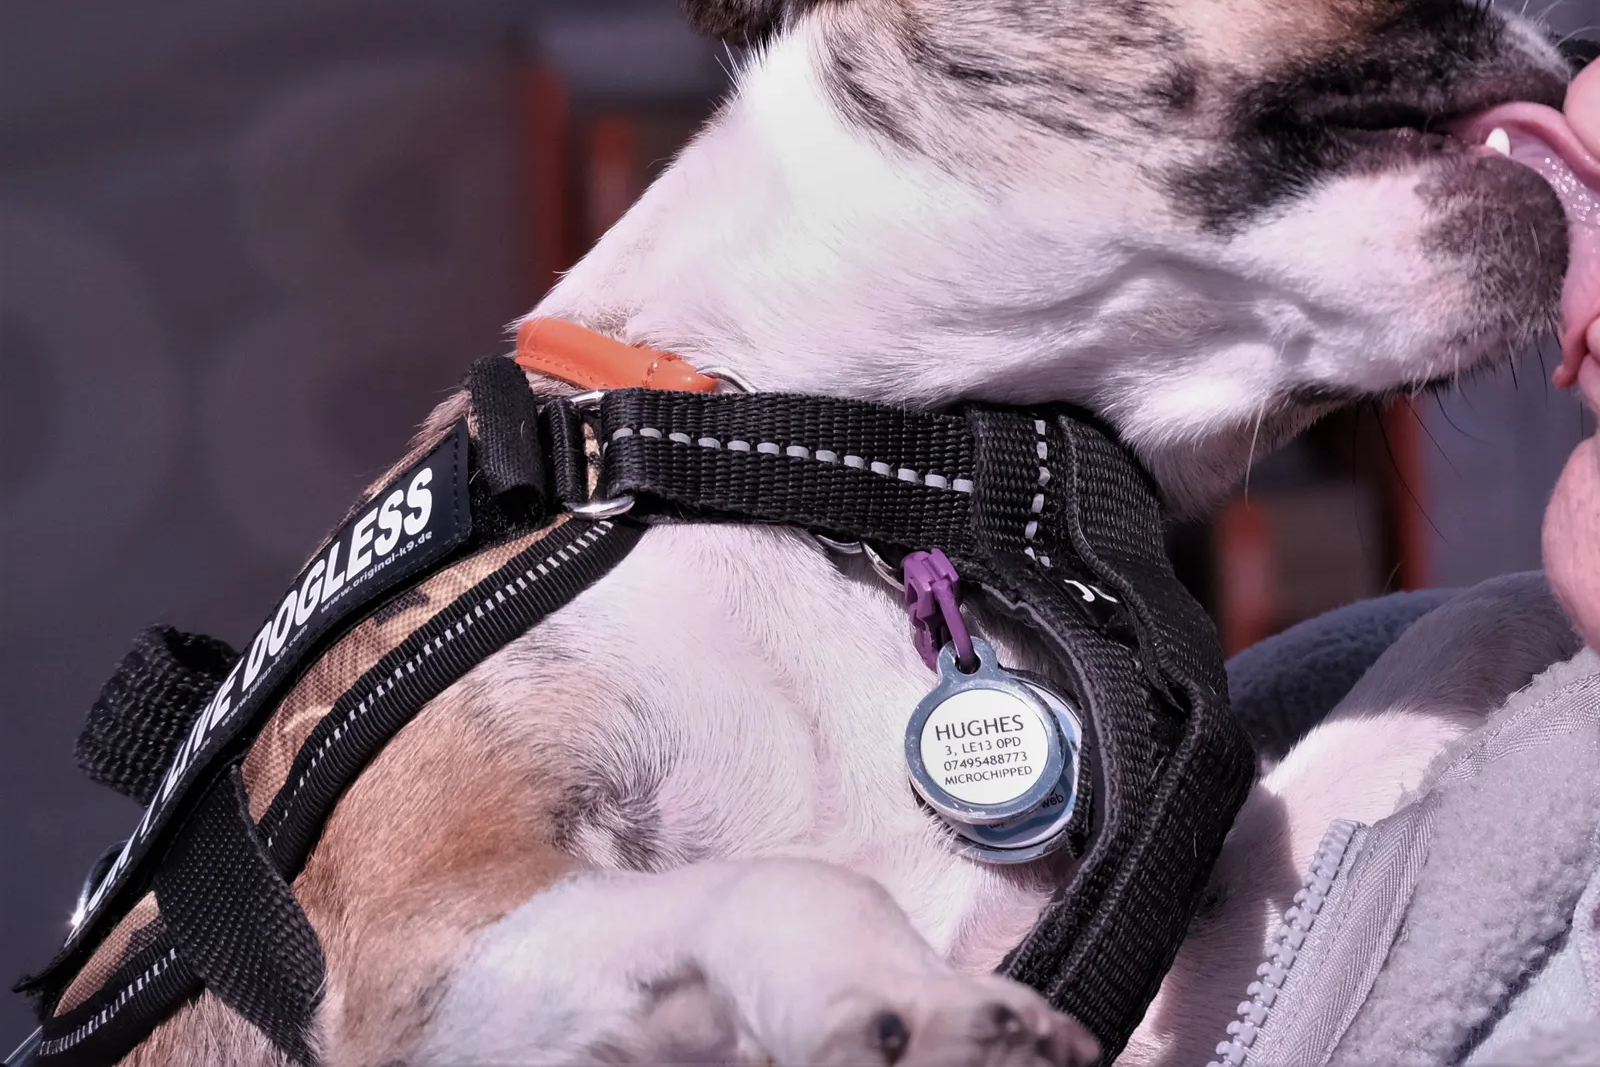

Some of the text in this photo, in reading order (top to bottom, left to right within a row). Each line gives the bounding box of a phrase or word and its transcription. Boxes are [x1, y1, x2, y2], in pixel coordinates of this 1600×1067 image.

[242, 467, 433, 693] DOGLESS
[320, 530, 433, 614] www.original-k9.de
[935, 714, 1024, 741] HUGHES
[945, 745, 958, 757] 3,
[962, 740, 993, 754] LE13
[943, 751, 1028, 772] 07495488773
[944, 765, 1033, 785] MICROCHIPPED
